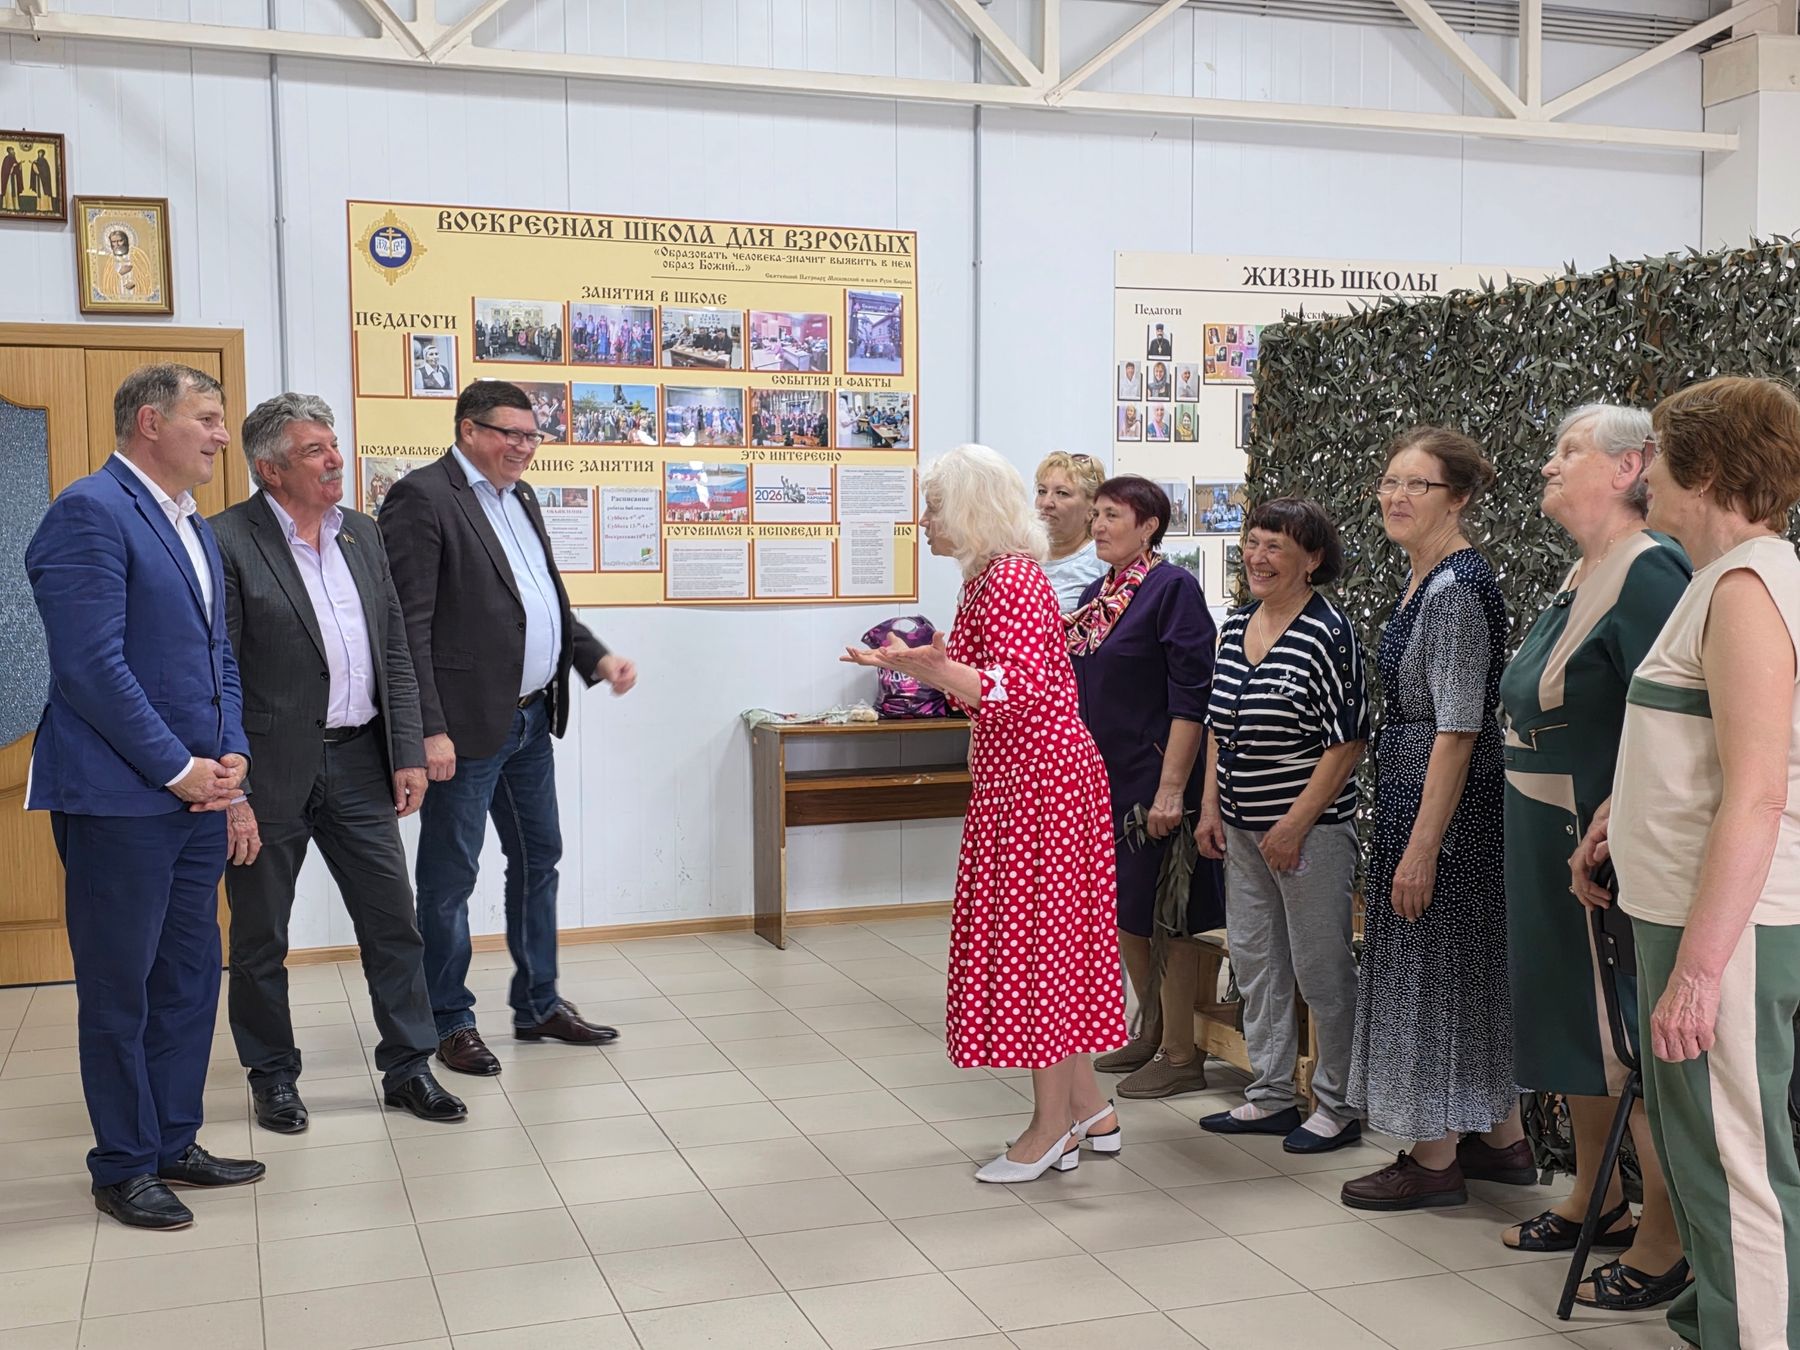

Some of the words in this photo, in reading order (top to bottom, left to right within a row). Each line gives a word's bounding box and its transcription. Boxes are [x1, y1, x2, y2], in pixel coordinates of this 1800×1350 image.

[437, 210, 614, 239] ВОСКРЕСНАЯ
[624, 220, 716, 245] ШКОЛА
[726, 226, 774, 250] ДЛЯ
[784, 229, 911, 254] ВЗРОСЛЫХ
[662, 260, 694, 271] образ
[829, 256, 877, 267] выявить
[1242, 266, 1335, 289] ЖИЗНЬ
[1340, 270, 1438, 292] ШКОЛЫ
[581, 285, 654, 301] ЗАНЯТИЯ
[674, 290, 728, 305] ШКОЛЕ
[1134, 303, 1182, 316] Педагоги
[355, 311, 457, 330] ПЕДАГОГИ
[771, 375, 830, 386] СОБЫТИЯ
[834, 376, 842, 386] И
[846, 376, 892, 388] ФАКТЫ
[741, 450, 765, 461] ЭТО
[770, 451, 842, 462] ИНТЕРЕСНО
[580, 459, 654, 473] ЗАНЯТИЯ
[755, 489, 782, 501] 2026
[667, 526, 742, 537] ГОТОВИМСЯ
[747, 526, 754, 536] К
[758, 526, 821, 538] ИСПОВЕДИ
[825, 526, 834, 536] И
